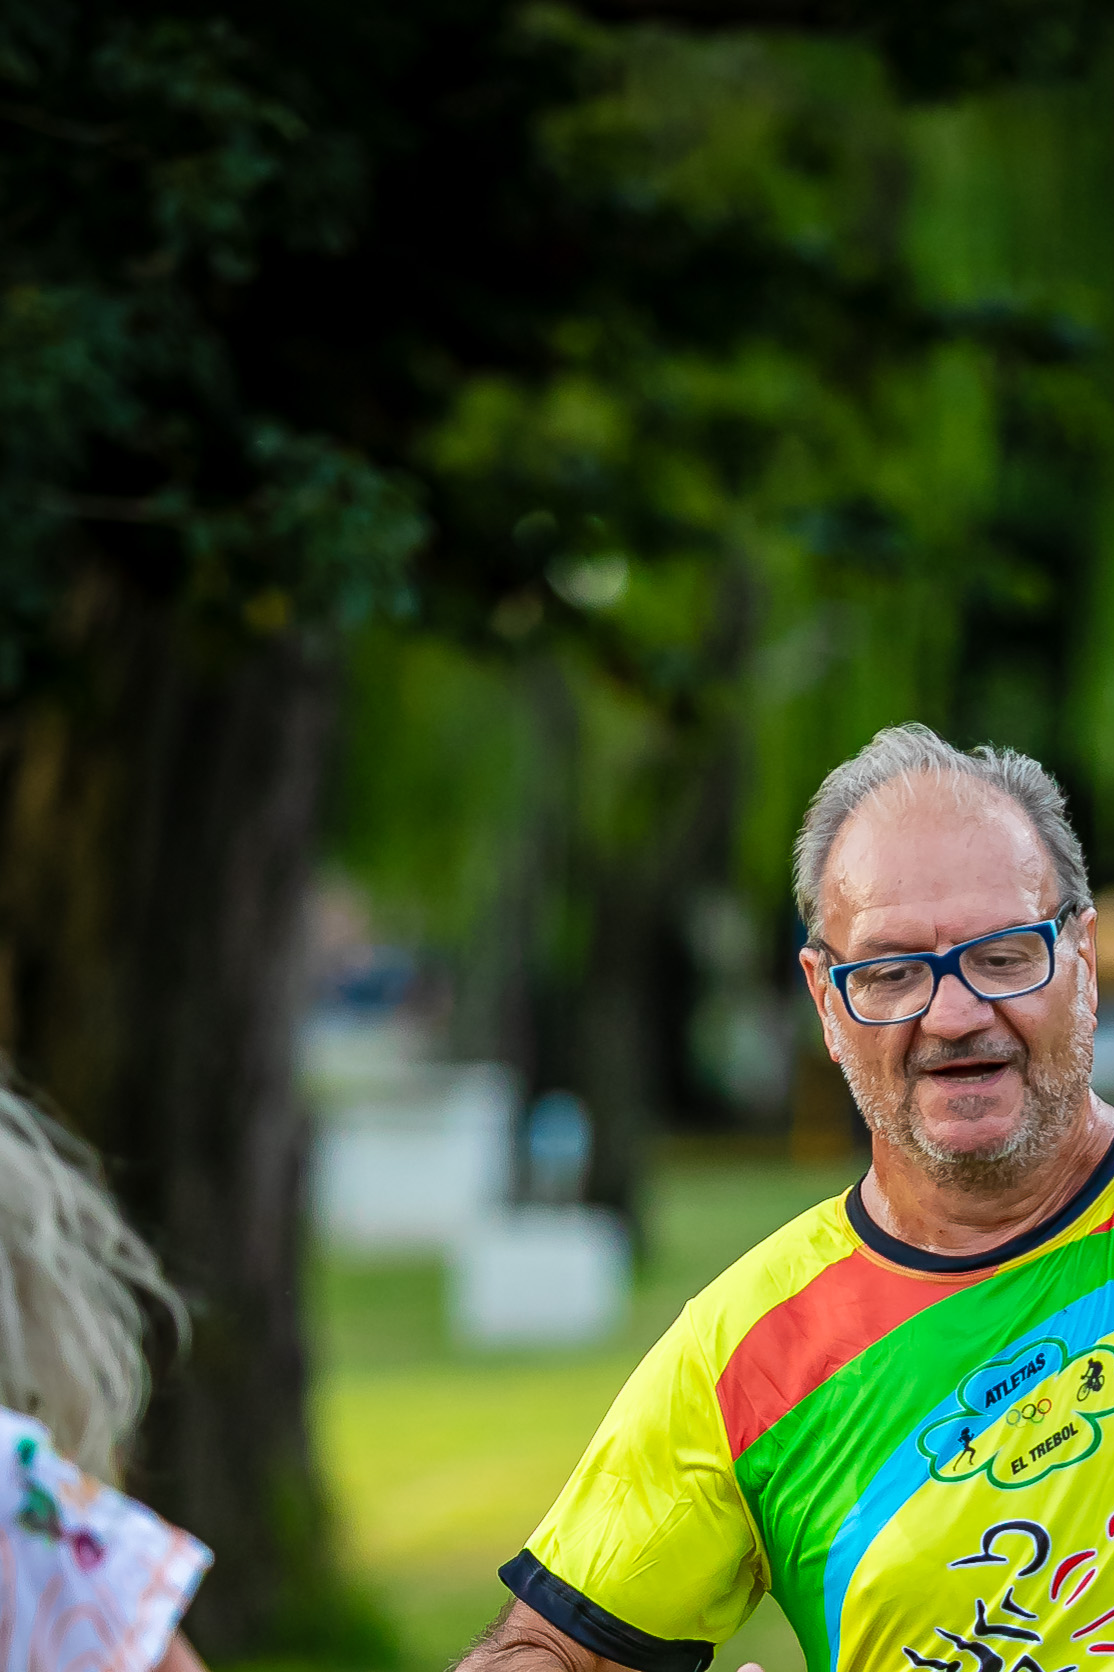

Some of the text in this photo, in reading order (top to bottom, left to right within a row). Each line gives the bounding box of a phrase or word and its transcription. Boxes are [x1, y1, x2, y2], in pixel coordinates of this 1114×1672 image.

[984, 1352, 1046, 1409] ATLETAS
[1011, 1422, 1079, 1475] EL TREBOL
